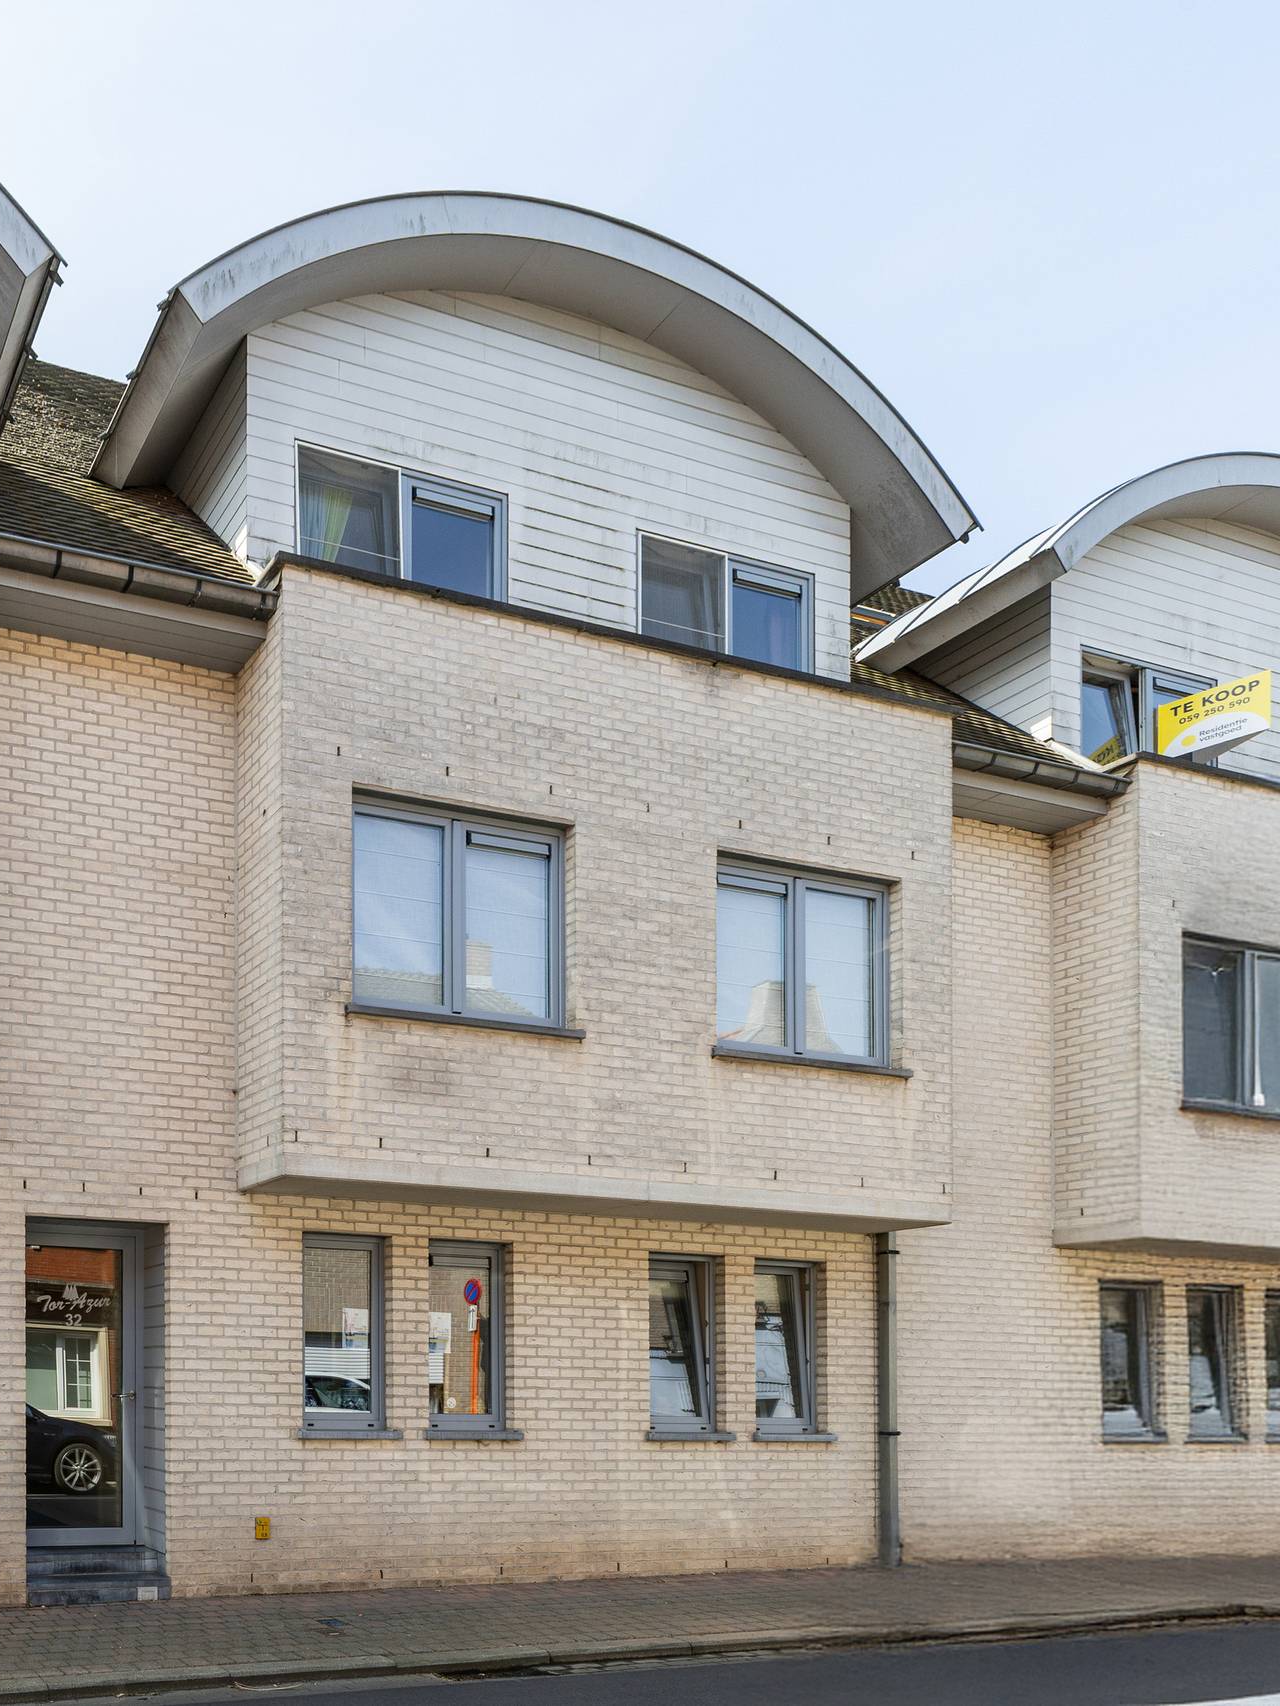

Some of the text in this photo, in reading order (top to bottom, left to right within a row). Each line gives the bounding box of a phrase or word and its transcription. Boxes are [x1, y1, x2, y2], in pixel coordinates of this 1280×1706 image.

[1170, 680, 1260, 717] TE KOOP
[1179, 697, 1250, 725] 059 250 590
[36, 1292, 112, 1313] Tor-Azur
[65, 1313, 82, 1327] 32
